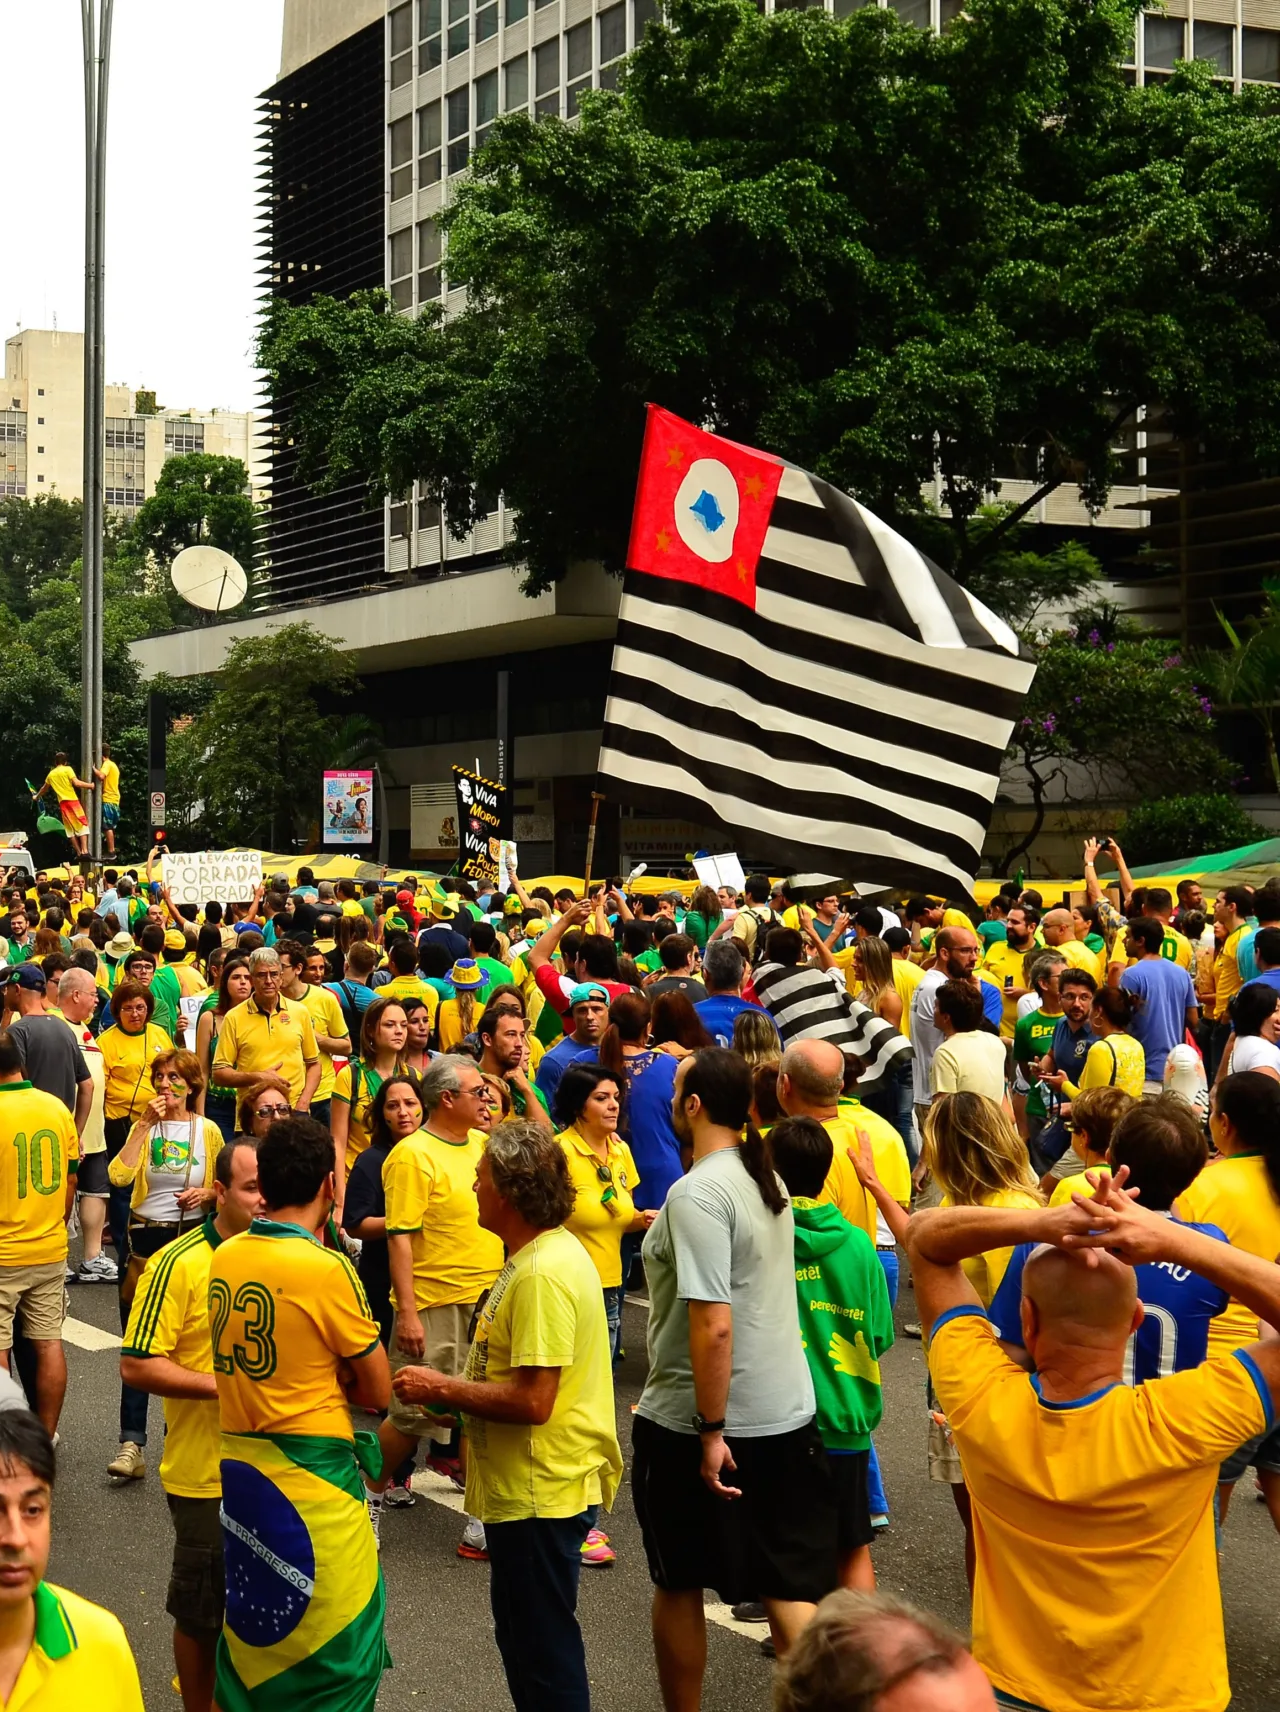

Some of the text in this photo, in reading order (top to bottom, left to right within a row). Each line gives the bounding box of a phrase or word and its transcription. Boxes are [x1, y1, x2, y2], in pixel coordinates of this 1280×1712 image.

[475, 784, 497, 808] VIVA
[465, 832, 487, 856] VIVA
[199, 854, 259, 864] LEVANDO
[462, 859, 499, 884] FEDERA
[13, 1129, 61, 1199] 10
[795, 1266, 821, 1281] etê!
[810, 1300, 864, 1321] perequetê!
[208, 1278, 277, 1382] 23
[235, 1524, 308, 1590] PROGRESSO
